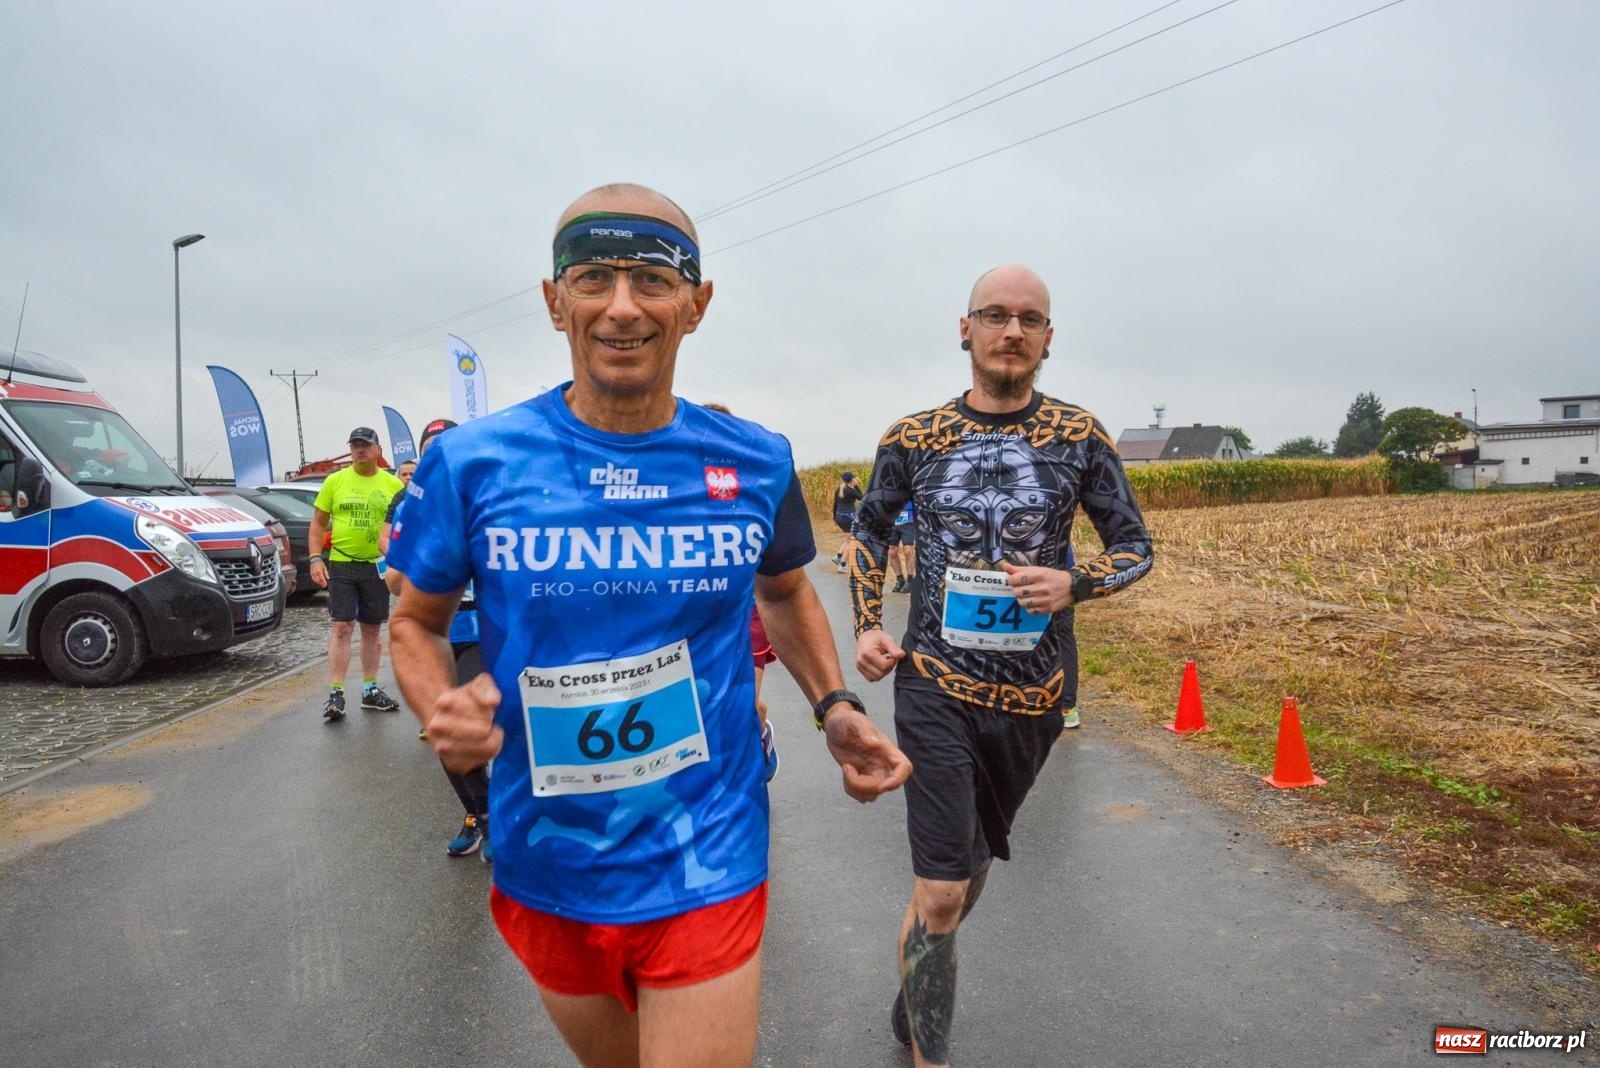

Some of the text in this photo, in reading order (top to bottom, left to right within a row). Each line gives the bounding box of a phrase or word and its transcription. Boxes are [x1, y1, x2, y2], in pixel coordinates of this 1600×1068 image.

[704, 456, 738, 465] POLAND
[589, 462, 639, 485] eko
[603, 485, 669, 499] okna
[485, 523, 766, 571] RUNNERS
[668, 577, 728, 594] TEAM
[951, 572, 971, 582] Eko
[974, 575, 1003, 585] Cross
[974, 598, 1023, 631] 54
[528, 652, 681, 688] Eko Cross przez Las
[577, 701, 655, 760] 66
